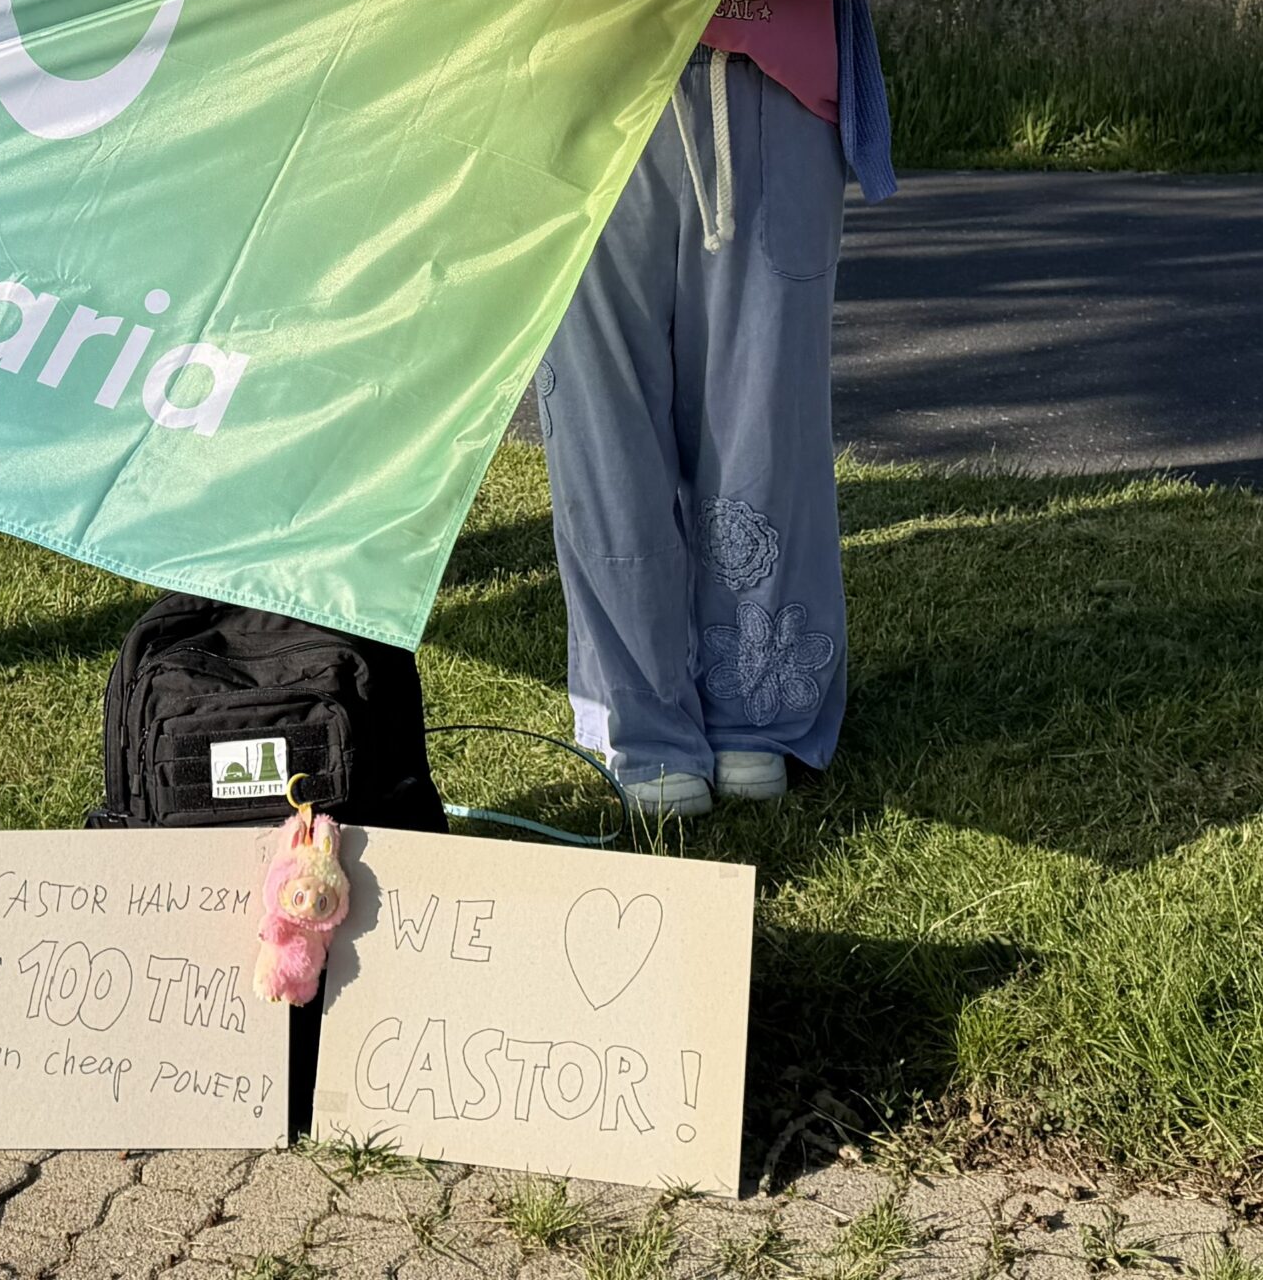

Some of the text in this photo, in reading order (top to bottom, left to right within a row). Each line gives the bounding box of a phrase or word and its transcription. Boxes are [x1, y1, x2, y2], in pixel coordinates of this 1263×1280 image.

[216, 784, 265, 797] LEGALIZE
[387, 889, 496, 963] WE
[17, 939, 134, 1032] 100
[145, 954, 247, 1034] TWh
[43, 1038, 134, 1103] cheap
